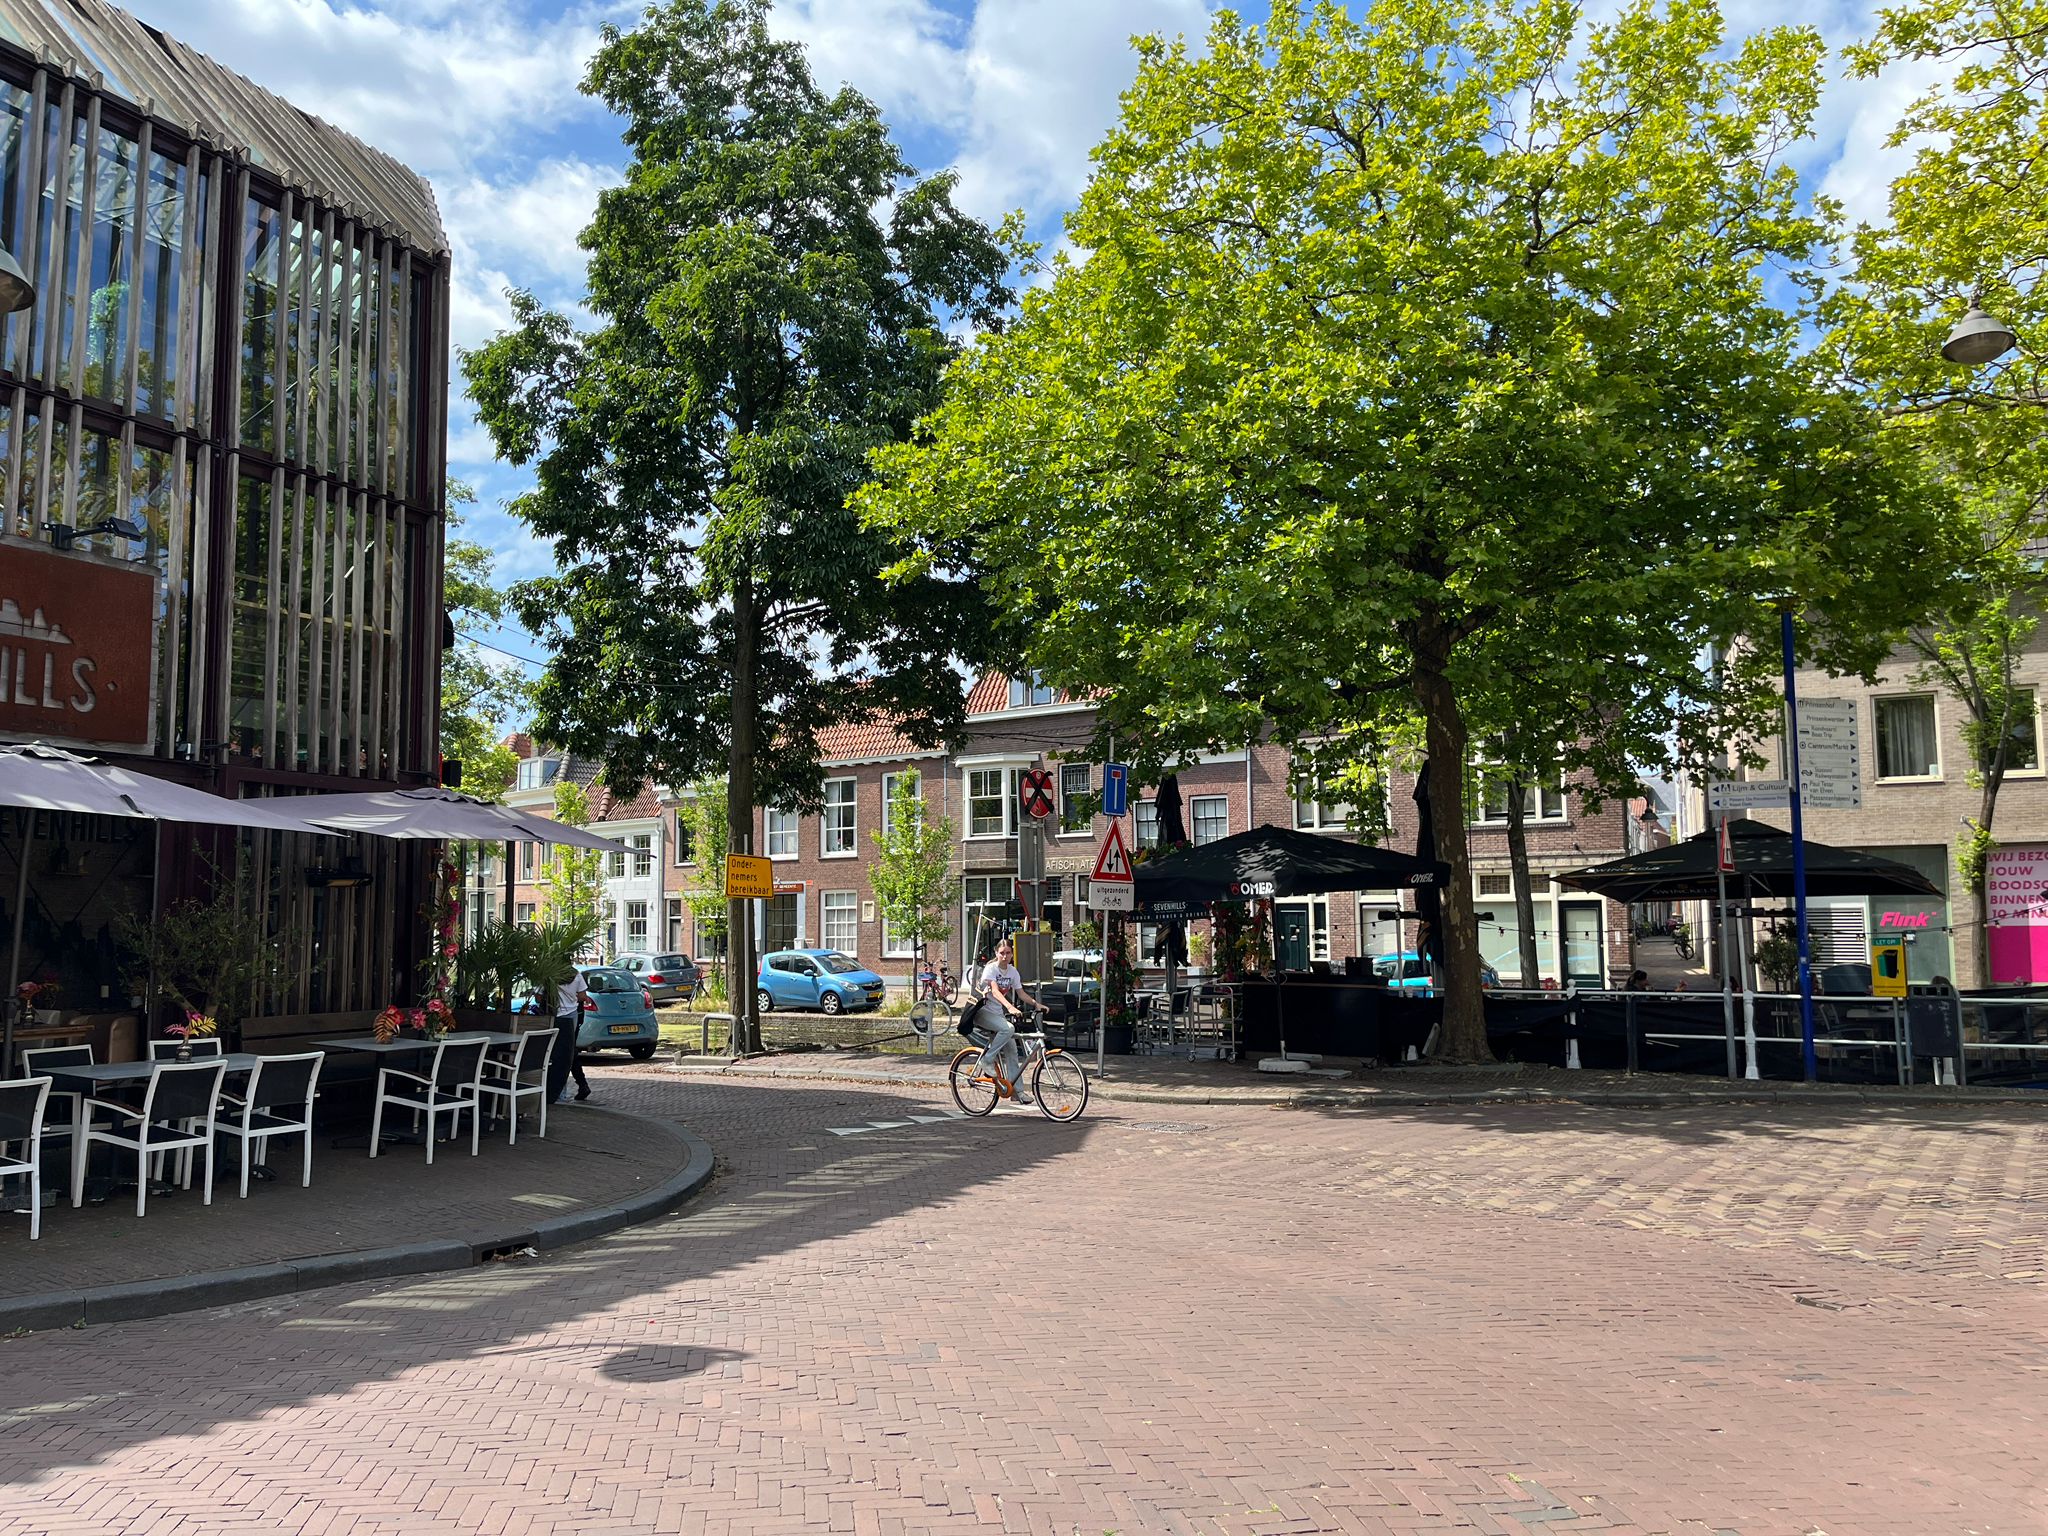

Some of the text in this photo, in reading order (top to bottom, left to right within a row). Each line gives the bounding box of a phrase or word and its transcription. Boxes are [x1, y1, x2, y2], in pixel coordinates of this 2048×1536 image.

[1732, 785, 1748, 793] Lijm
[1758, 783, 1786, 791] Cultuur
[1987, 852, 2013, 862] WIJ
[731, 858, 757, 868] Onder-
[1988, 866, 2033, 876] JOUW
[730, 873, 758, 882] nemers
[730, 884, 770, 895] bereikbaar
[1096, 887, 1129, 895] uitgezonderd
[1990, 895, 2047, 905] BINNEN
[1879, 911, 1930, 927] Flink
